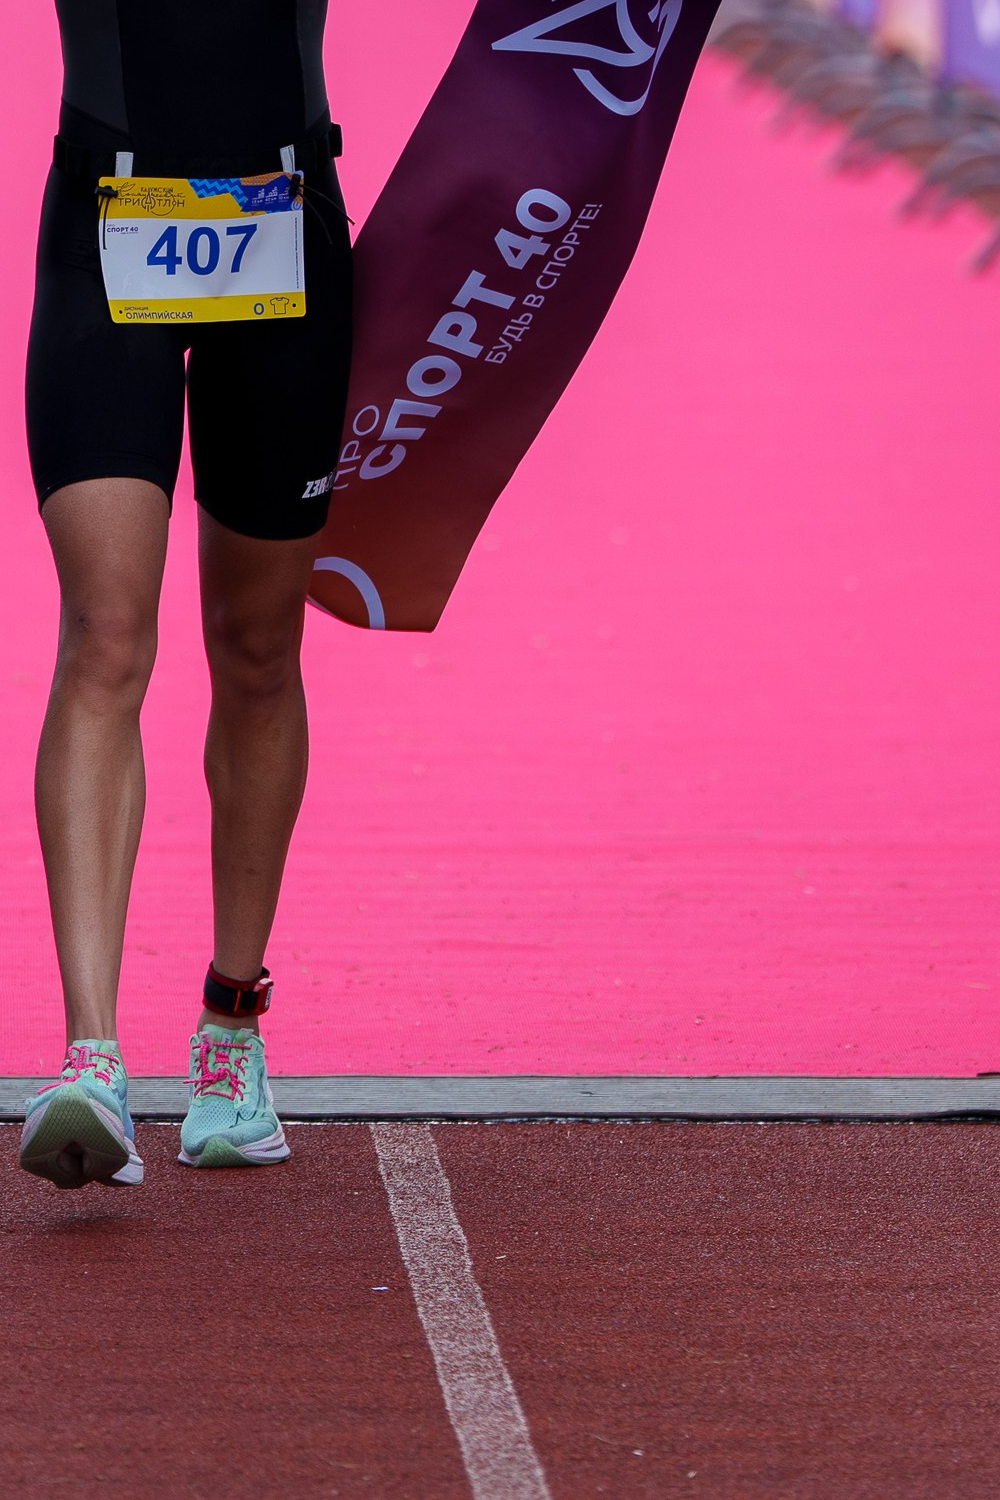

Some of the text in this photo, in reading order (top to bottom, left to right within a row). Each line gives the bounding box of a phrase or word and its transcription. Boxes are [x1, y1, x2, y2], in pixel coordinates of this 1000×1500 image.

[146, 223, 258, 276] 407
[485, 203, 604, 364] БУДЬ В СПОРТЕ!
[125, 309, 194, 320] ОЛИМПИЙСКАЯ
[359, 188, 572, 479] СПОРТ 40
